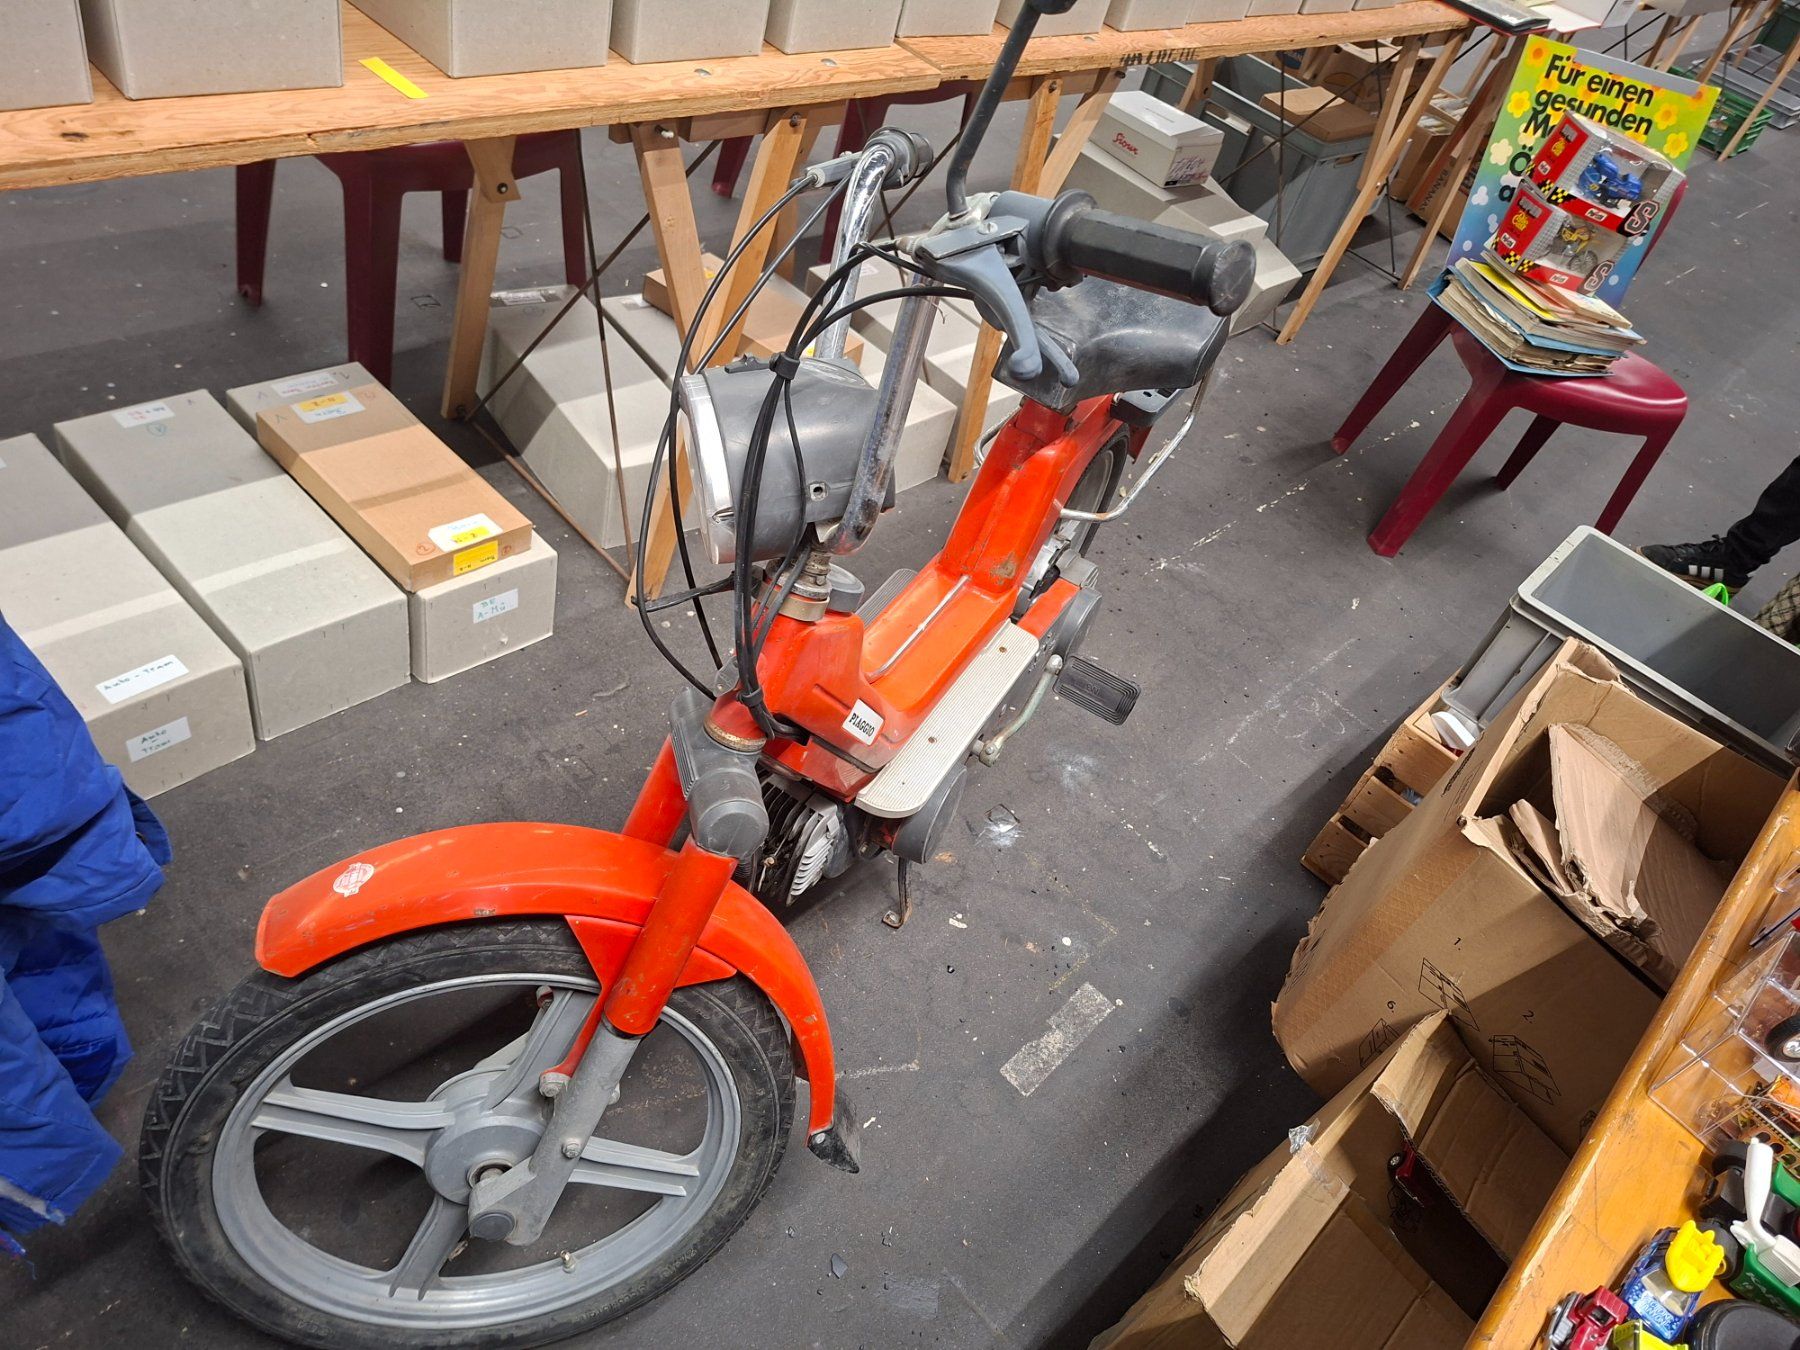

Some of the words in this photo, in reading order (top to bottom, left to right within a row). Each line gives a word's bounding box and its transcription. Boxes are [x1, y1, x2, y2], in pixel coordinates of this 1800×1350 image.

[1545, 53, 1585, 87] Für
[1587, 72, 1654, 107] einen
[1535, 88, 1653, 136] gesunden
[849, 712, 875, 737] PIAGGIO
